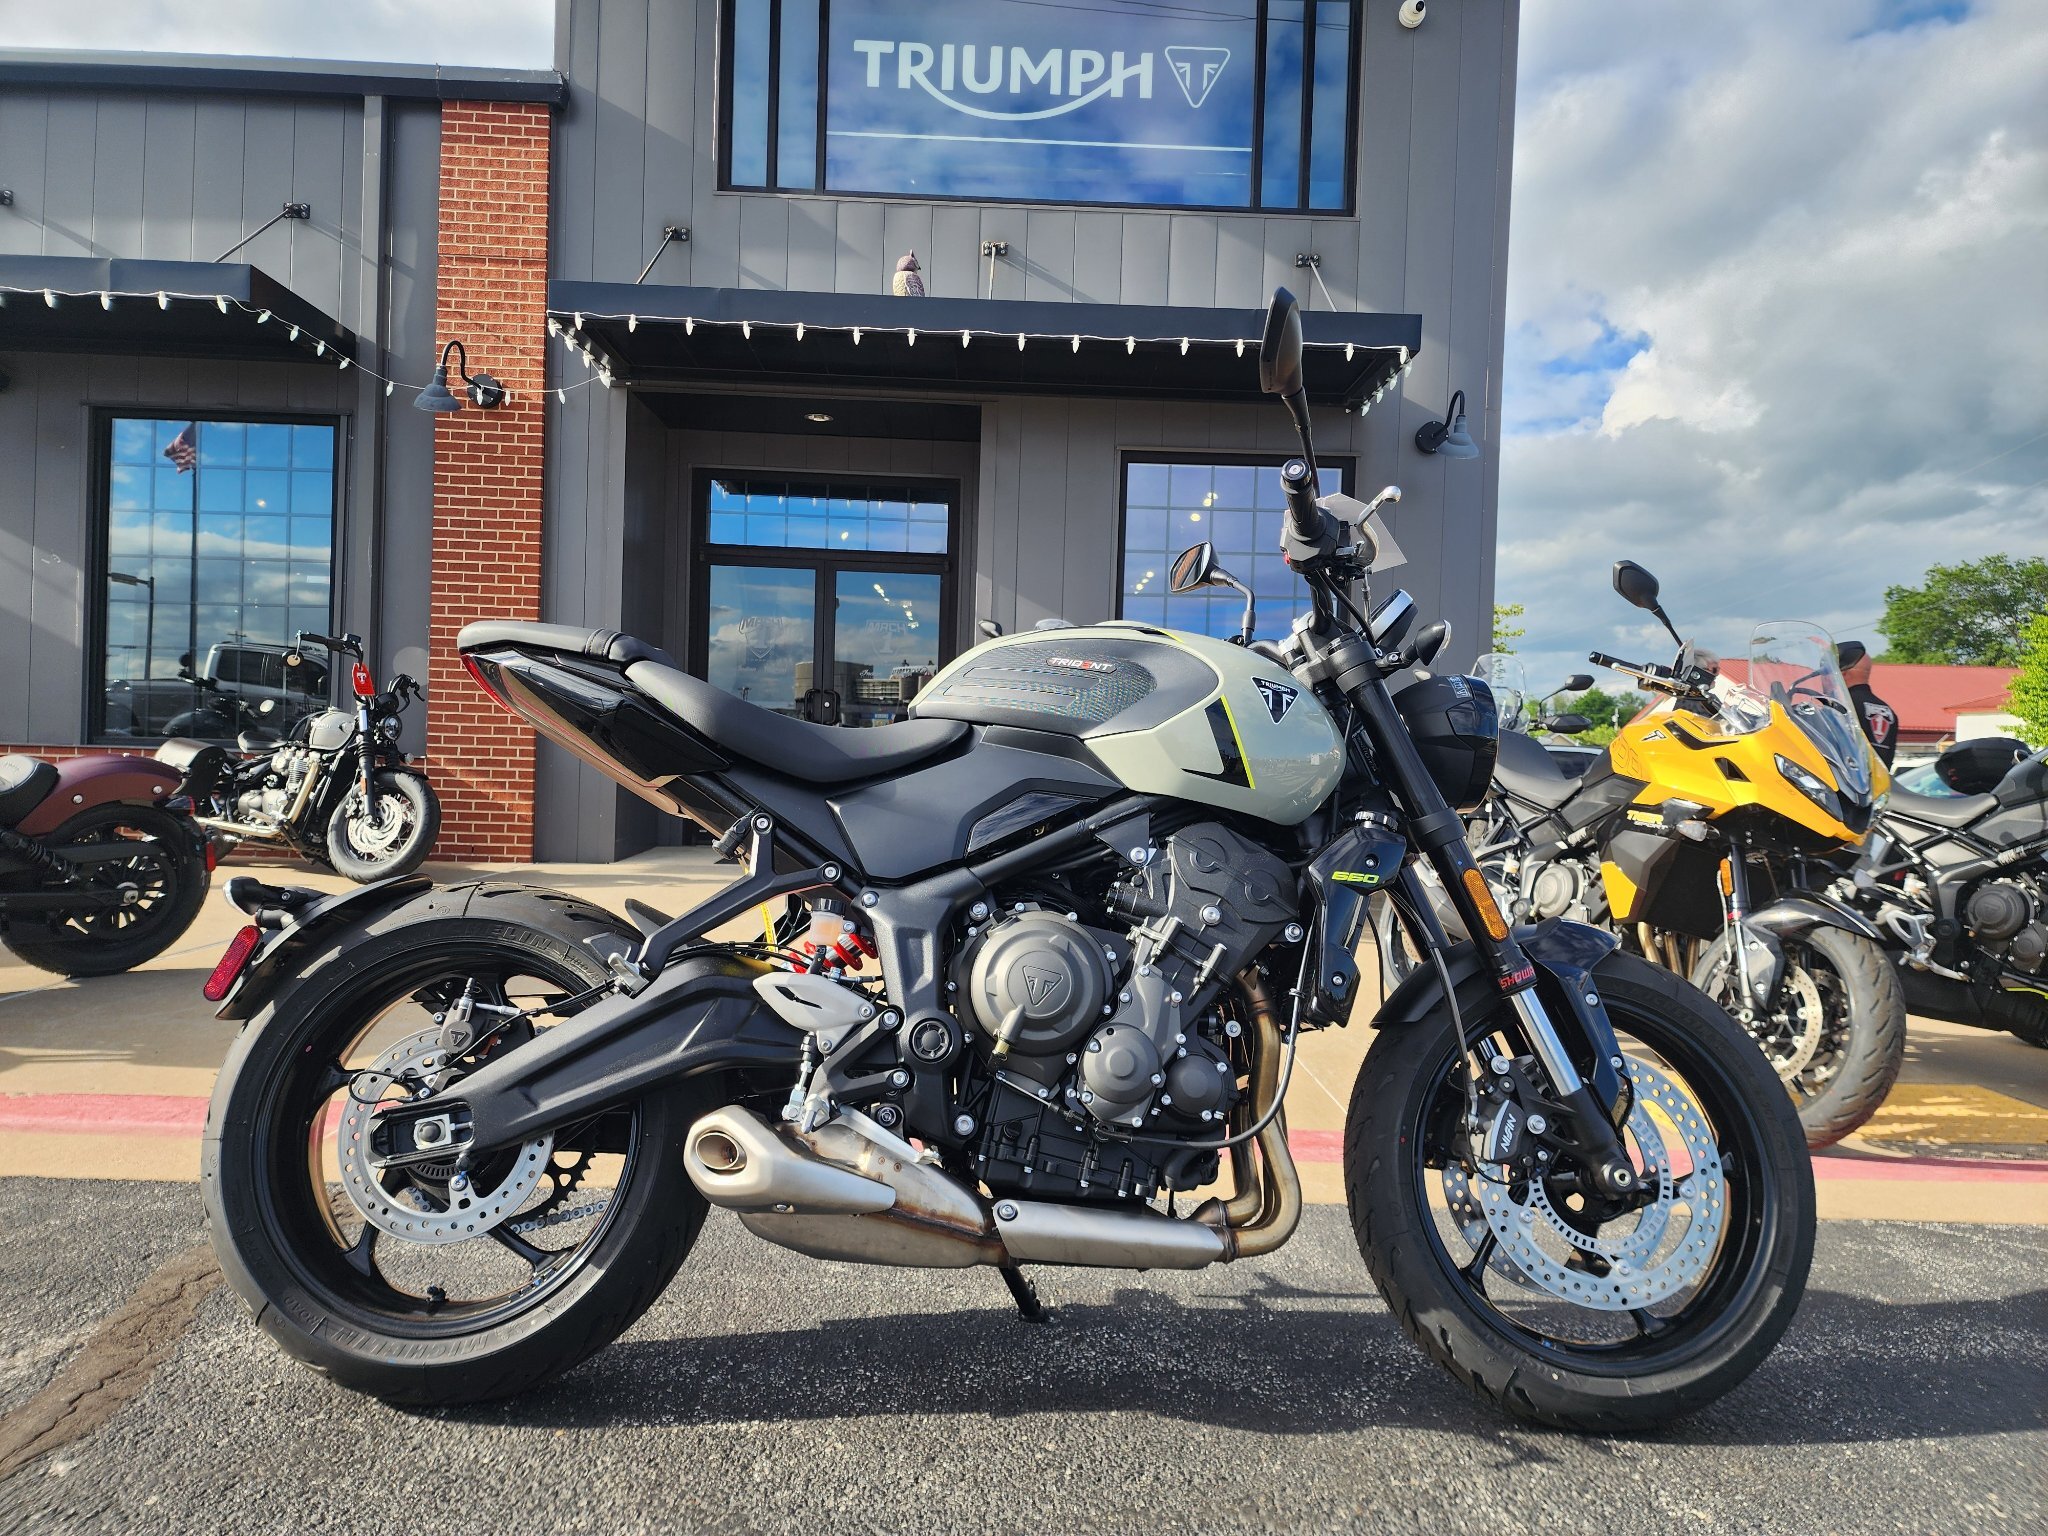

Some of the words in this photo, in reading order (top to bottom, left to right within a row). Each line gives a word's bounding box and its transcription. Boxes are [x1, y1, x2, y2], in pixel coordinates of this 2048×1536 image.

[853, 39, 1154, 121] TRIUMPH
[865, 621, 906, 633] MACH
[1051, 657, 1113, 671] TRIDENT
[1260, 680, 1291, 693] TRIUMPH
[1331, 871, 1379, 884] 660
[330, 1328, 489, 1360] MICHELIN
